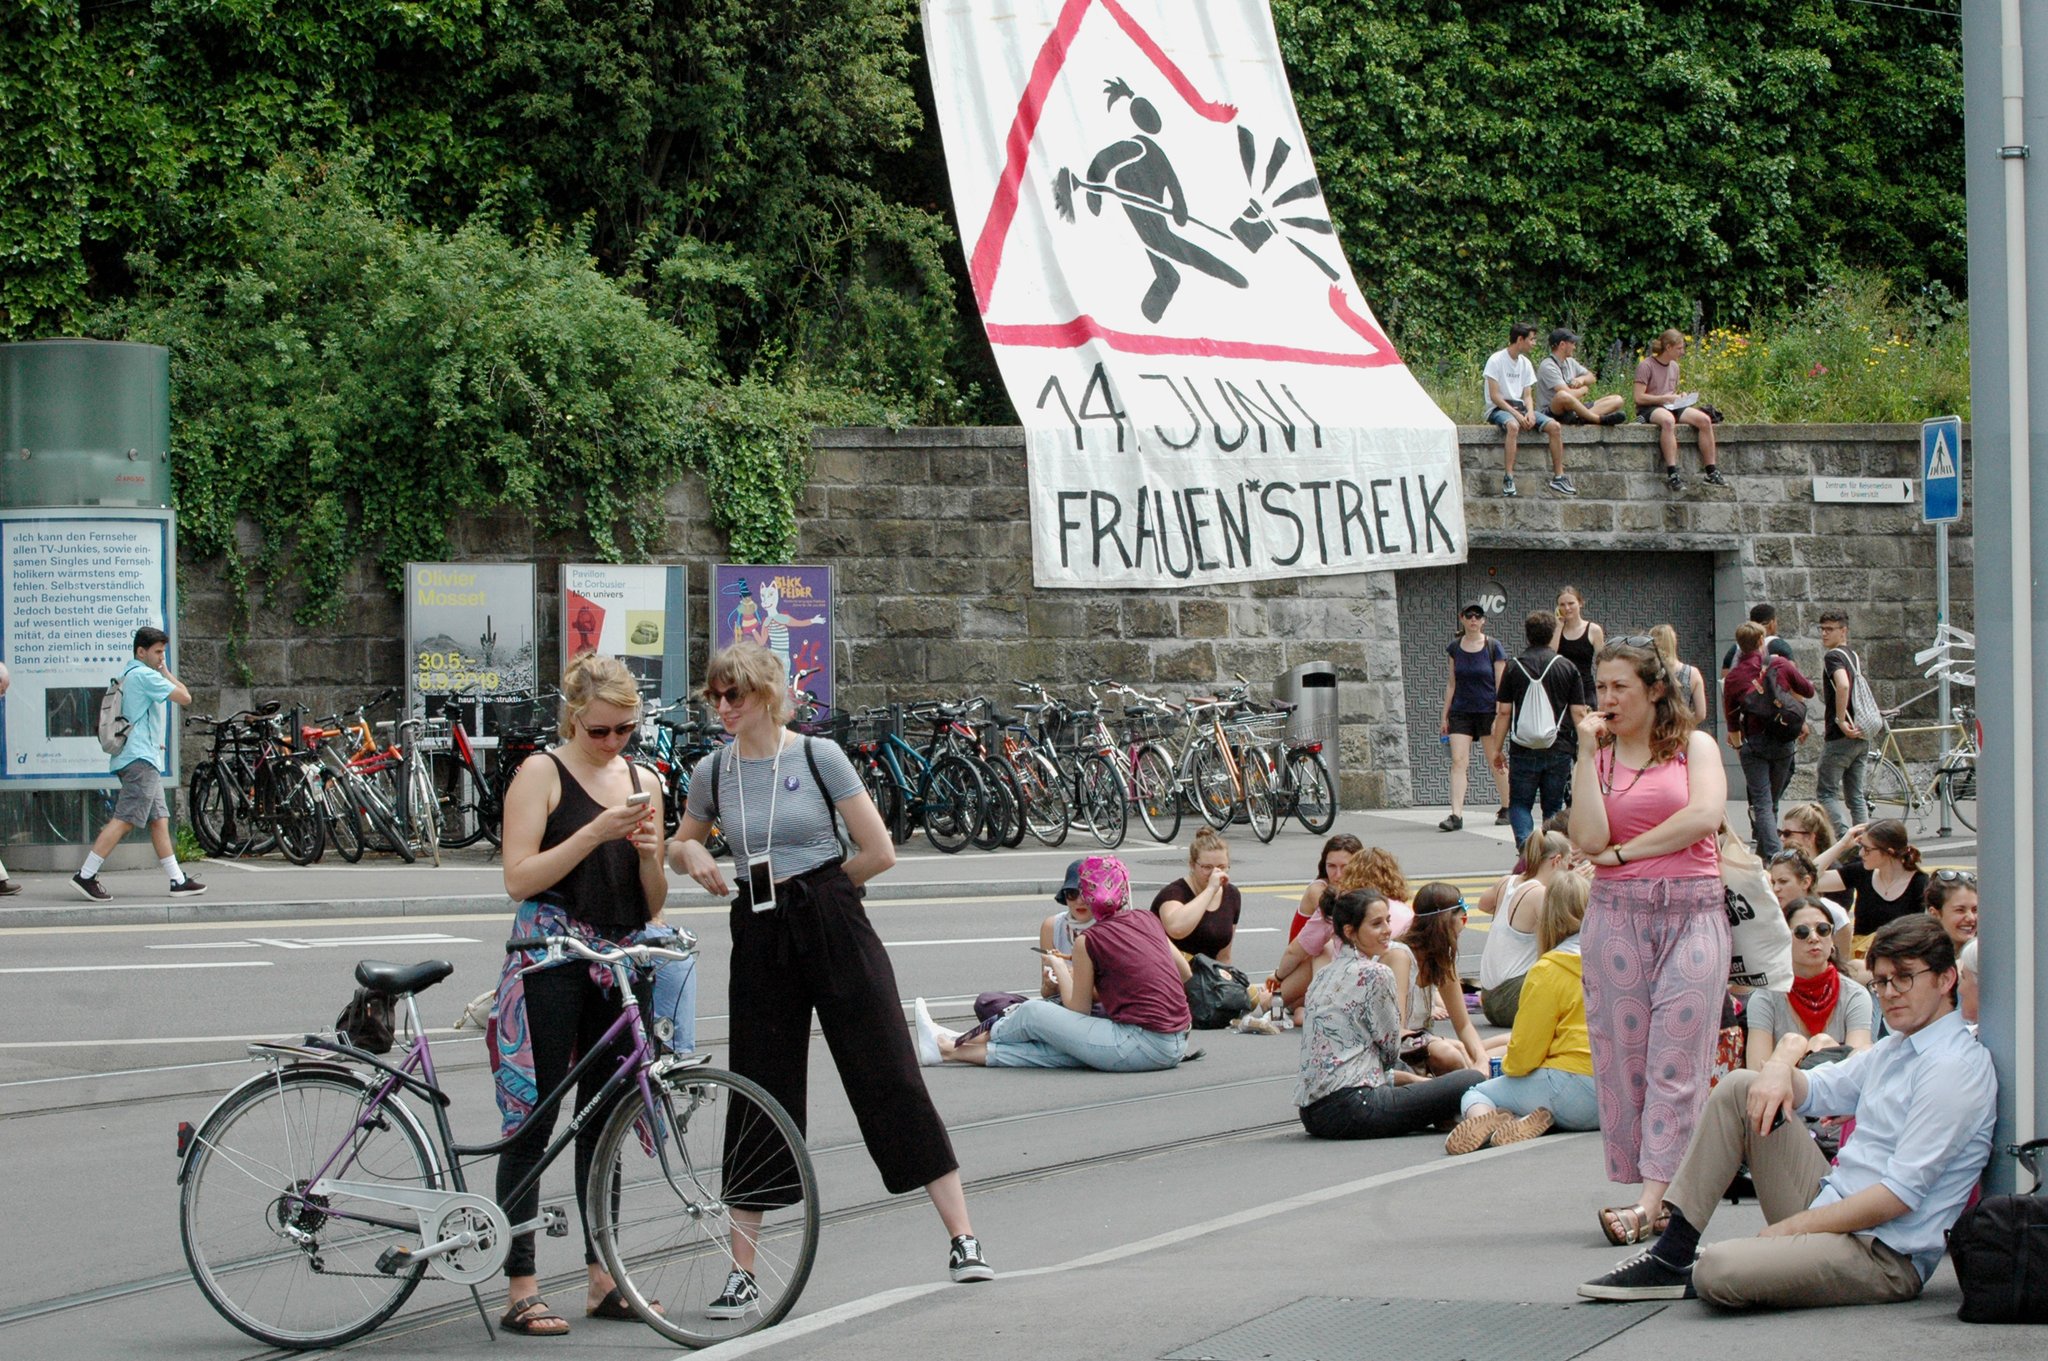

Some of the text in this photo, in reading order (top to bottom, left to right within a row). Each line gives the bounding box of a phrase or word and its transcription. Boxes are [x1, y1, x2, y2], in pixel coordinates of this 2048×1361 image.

[1138, 374, 1322, 453] JUNI
[37, 532, 63, 542] kann
[66, 532, 86, 542] den
[89, 531, 137, 542] Fernseher
[13, 544, 151, 555] allen TV-Junkies, sowie ein-
[13, 556, 154, 567] samen Singles und Fernseh-
[13, 568, 143, 580] holikern wärmstens emp-
[417, 569, 476, 587] Olivier
[572, 570, 605, 578] Pavillon
[13, 580, 145, 591] fehlen. Selbstverständlich
[572, 580, 626, 589] Le Corbusier
[572, 590, 624, 599] Mon univers
[780, 586, 814, 599] FELDER
[13, 594, 38, 603] auch
[418, 590, 486, 607] Mosset
[1478, 594, 1506, 613] WC
[14, 605, 148, 616] Jedoch besteht die Gefahr
[14, 618, 30, 628] auf
[33, 617, 90, 627] wesentlich
[93, 617, 133, 628] weniger
[14, 630, 44, 641] mität,
[47, 630, 61, 639] da
[64, 629, 92, 639] einen
[95, 629, 128, 639] dieses
[14, 641, 134, 653] schon ziemlich in seine
[14, 655, 41, 665] Bann
[458, 696, 476, 704] haus
[570, 1091, 602, 1131] gretener
